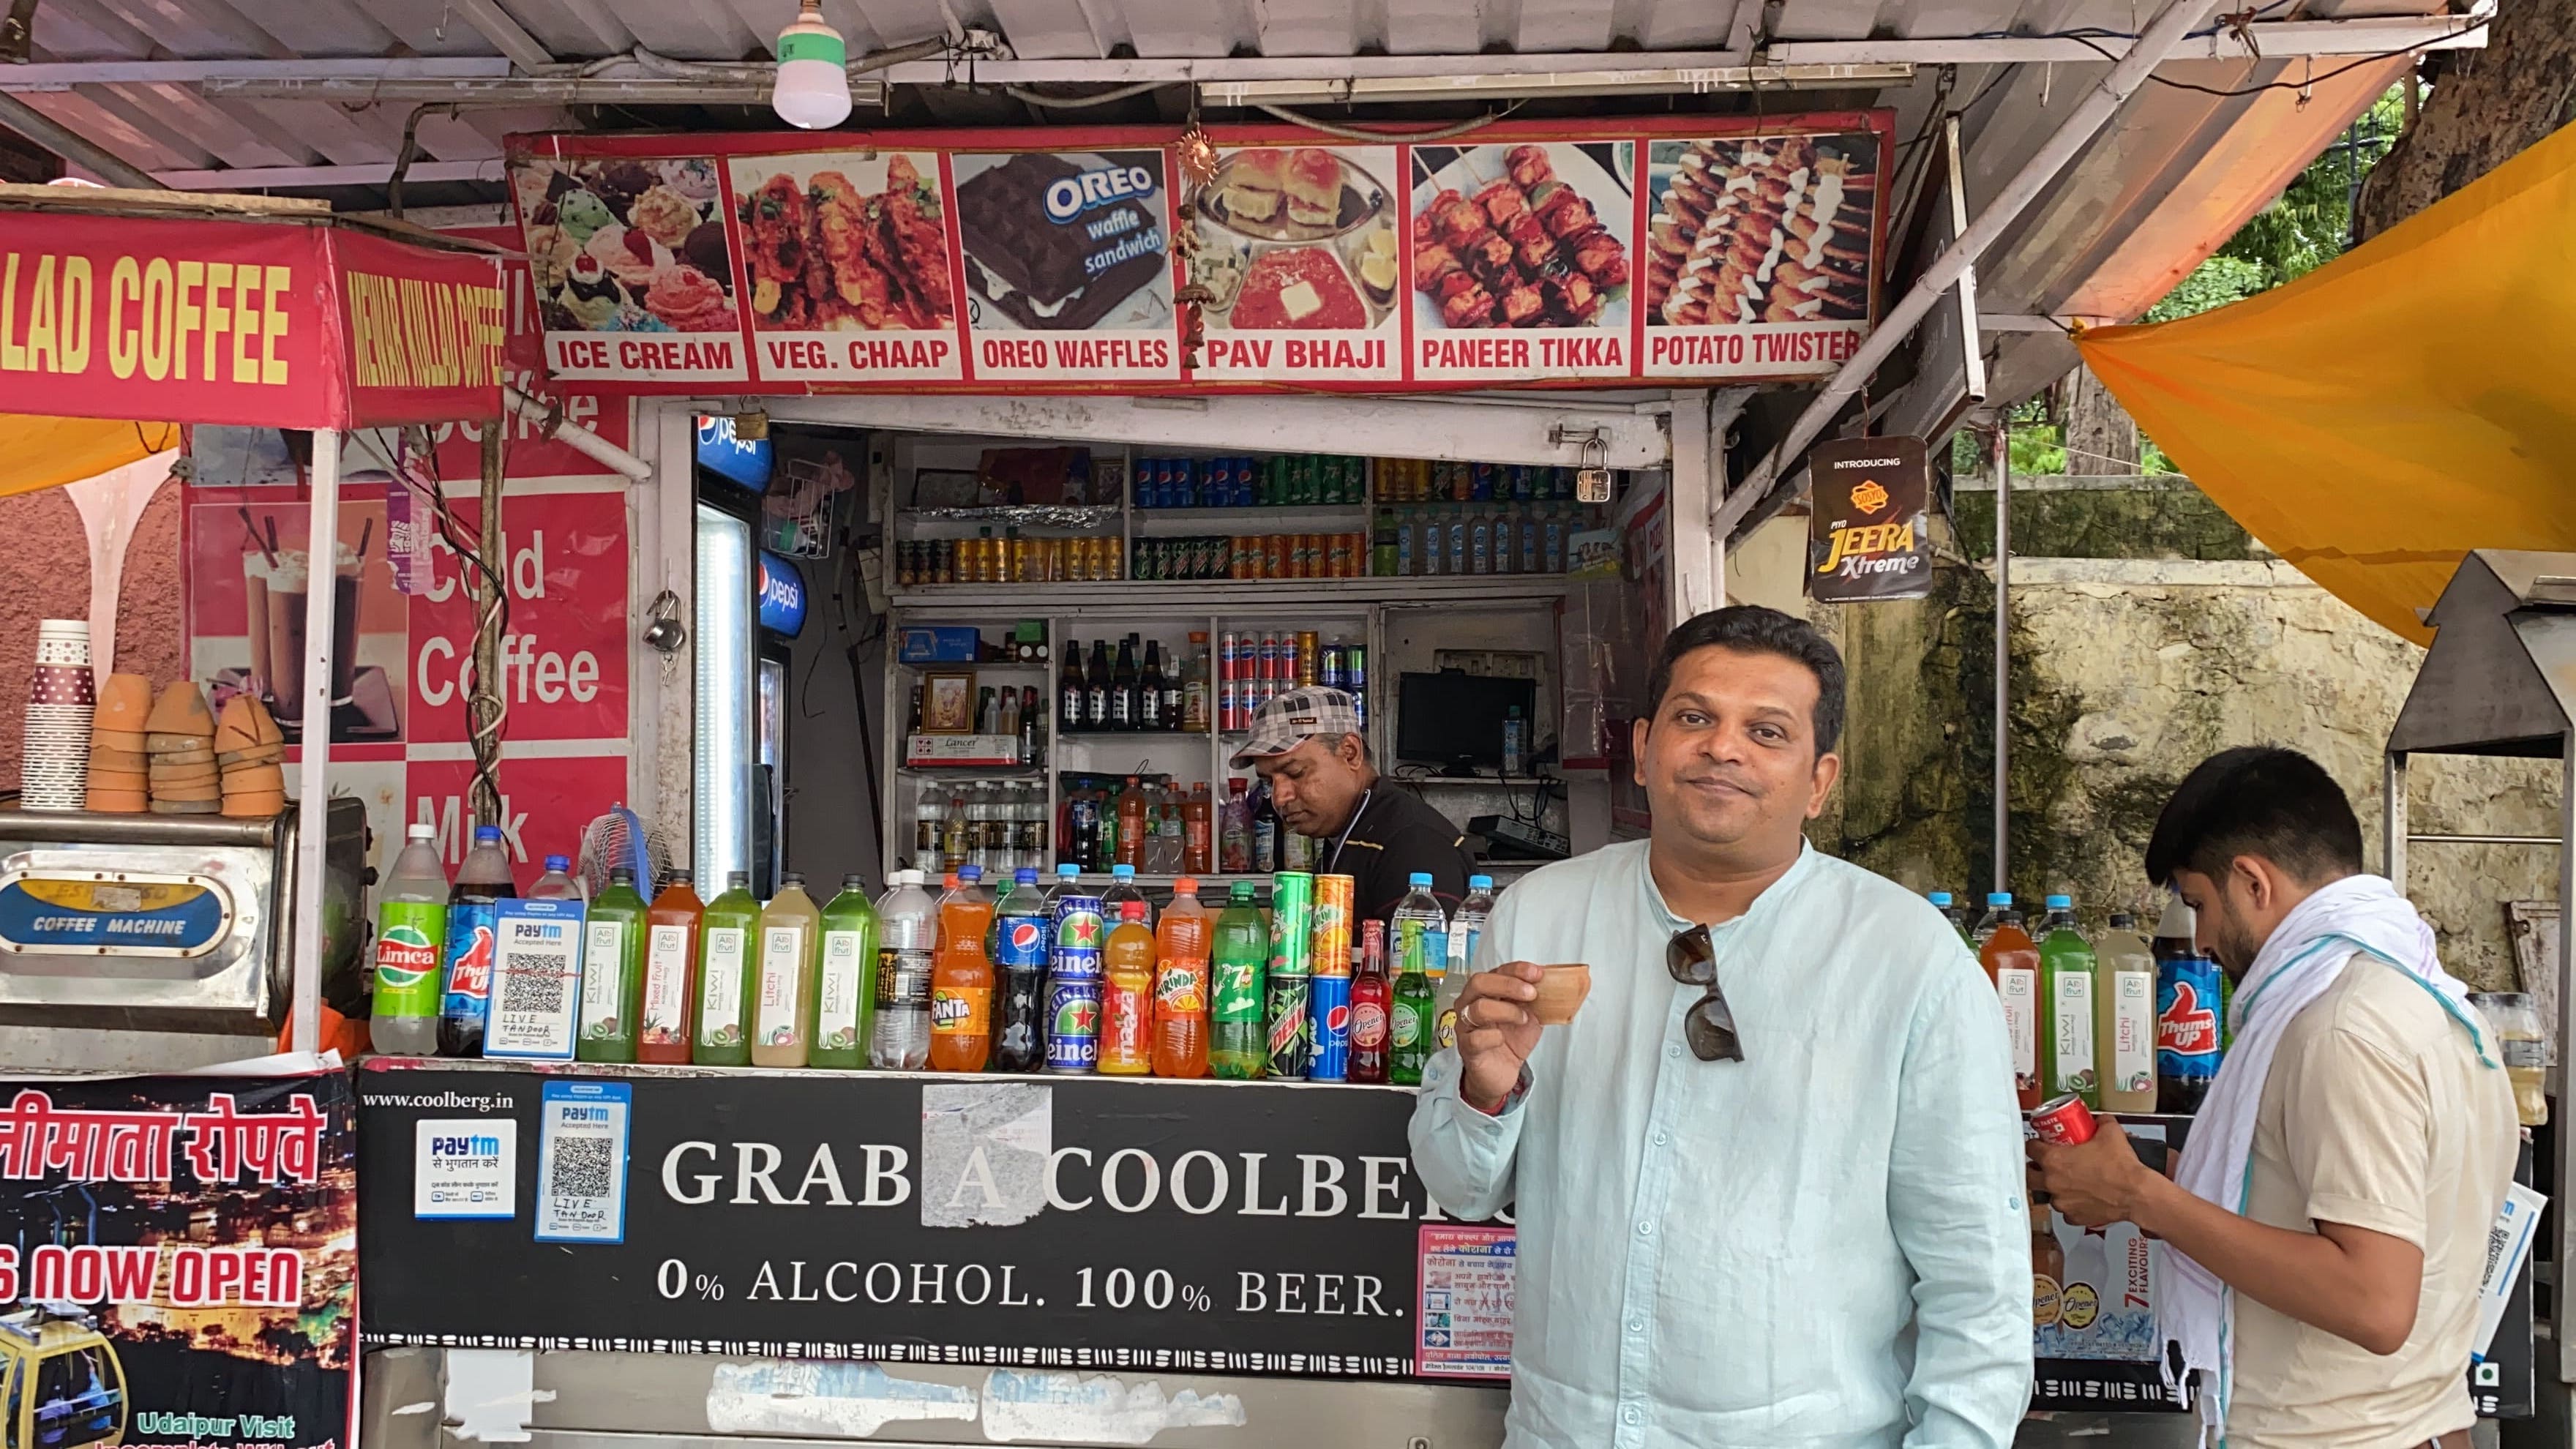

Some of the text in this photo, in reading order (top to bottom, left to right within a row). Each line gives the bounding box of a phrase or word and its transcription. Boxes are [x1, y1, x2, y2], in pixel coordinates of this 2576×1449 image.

[1044, 167, 1152, 218] OREO
[1086, 211, 1140, 242] waffle
[1085, 229, 1161, 273] sandwich
[108, 256, 291, 385] COFFEE
[400, 278, 460, 389] KULLAD
[558, 341, 733, 370] ICE CREAM
[767, 340, 948, 369] VEG. CHAAP
[983, 340, 1168, 367] OREO WAFFLES
[1208, 340, 1386, 369] PAV BHAJI
[1422, 338, 1623, 368] PANEER TIKKA
[1652, 331, 1860, 364] POTATO TWISTER
[1834, 457, 1901, 470] INTRODUCING
[1831, 520, 1847, 530] PIYO
[1818, 519, 1914, 573] JEERA
[1840, 555, 1920, 580] Xtreme
[768, 577, 798, 612] pepsi
[945, 738, 976, 747] Lancer
[34, 917, 186, 935] COFFEE MACHINE
[514, 924, 562, 938] paytm
[376, 945, 435, 965] Limca
[649, 983, 662, 1011] Mixed
[763, 972, 776, 1007] Litchi
[503, 1014, 537, 1024] LIVE
[1354, 1015, 1383, 1034] Opener
[2160, 1019, 2213, 1037] Thums
[1330, 1040, 1348, 1049] peps
[2119, 1016, 2130, 1052] Litchi
[2175, 1031, 2201, 1048] UP
[363, 1092, 513, 1113] www.coolberg.in
[562, 1106, 609, 1121] paytm
[2040, 1117, 2059, 1126] TASTE
[184, 1093, 328, 1183] रोपवे
[433, 1134, 499, 1156] paytm
[433, 1156, 498, 1172] से भुगतान करें
[662, 1141, 1516, 1225] GRAB A COOLBE
[554, 1198, 591, 1208] LIVE
[1426, 1256, 1456, 1267] कोरोना
[2127, 1237, 2137, 1294] EXCITING
[31, 1246, 160, 1306] NOW
[171, 1248, 303, 1307] OPEN
[746, 1260, 1045, 1307] ALCOHOL.
[1236, 1271, 1404, 1317] BEER.
[2035, 1292, 2058, 1308] pener
[2065, 1297, 2097, 1312] Opener
[2125, 1293, 2149, 1308] 7
[137, 1412, 296, 1439] Udaipur Visit
